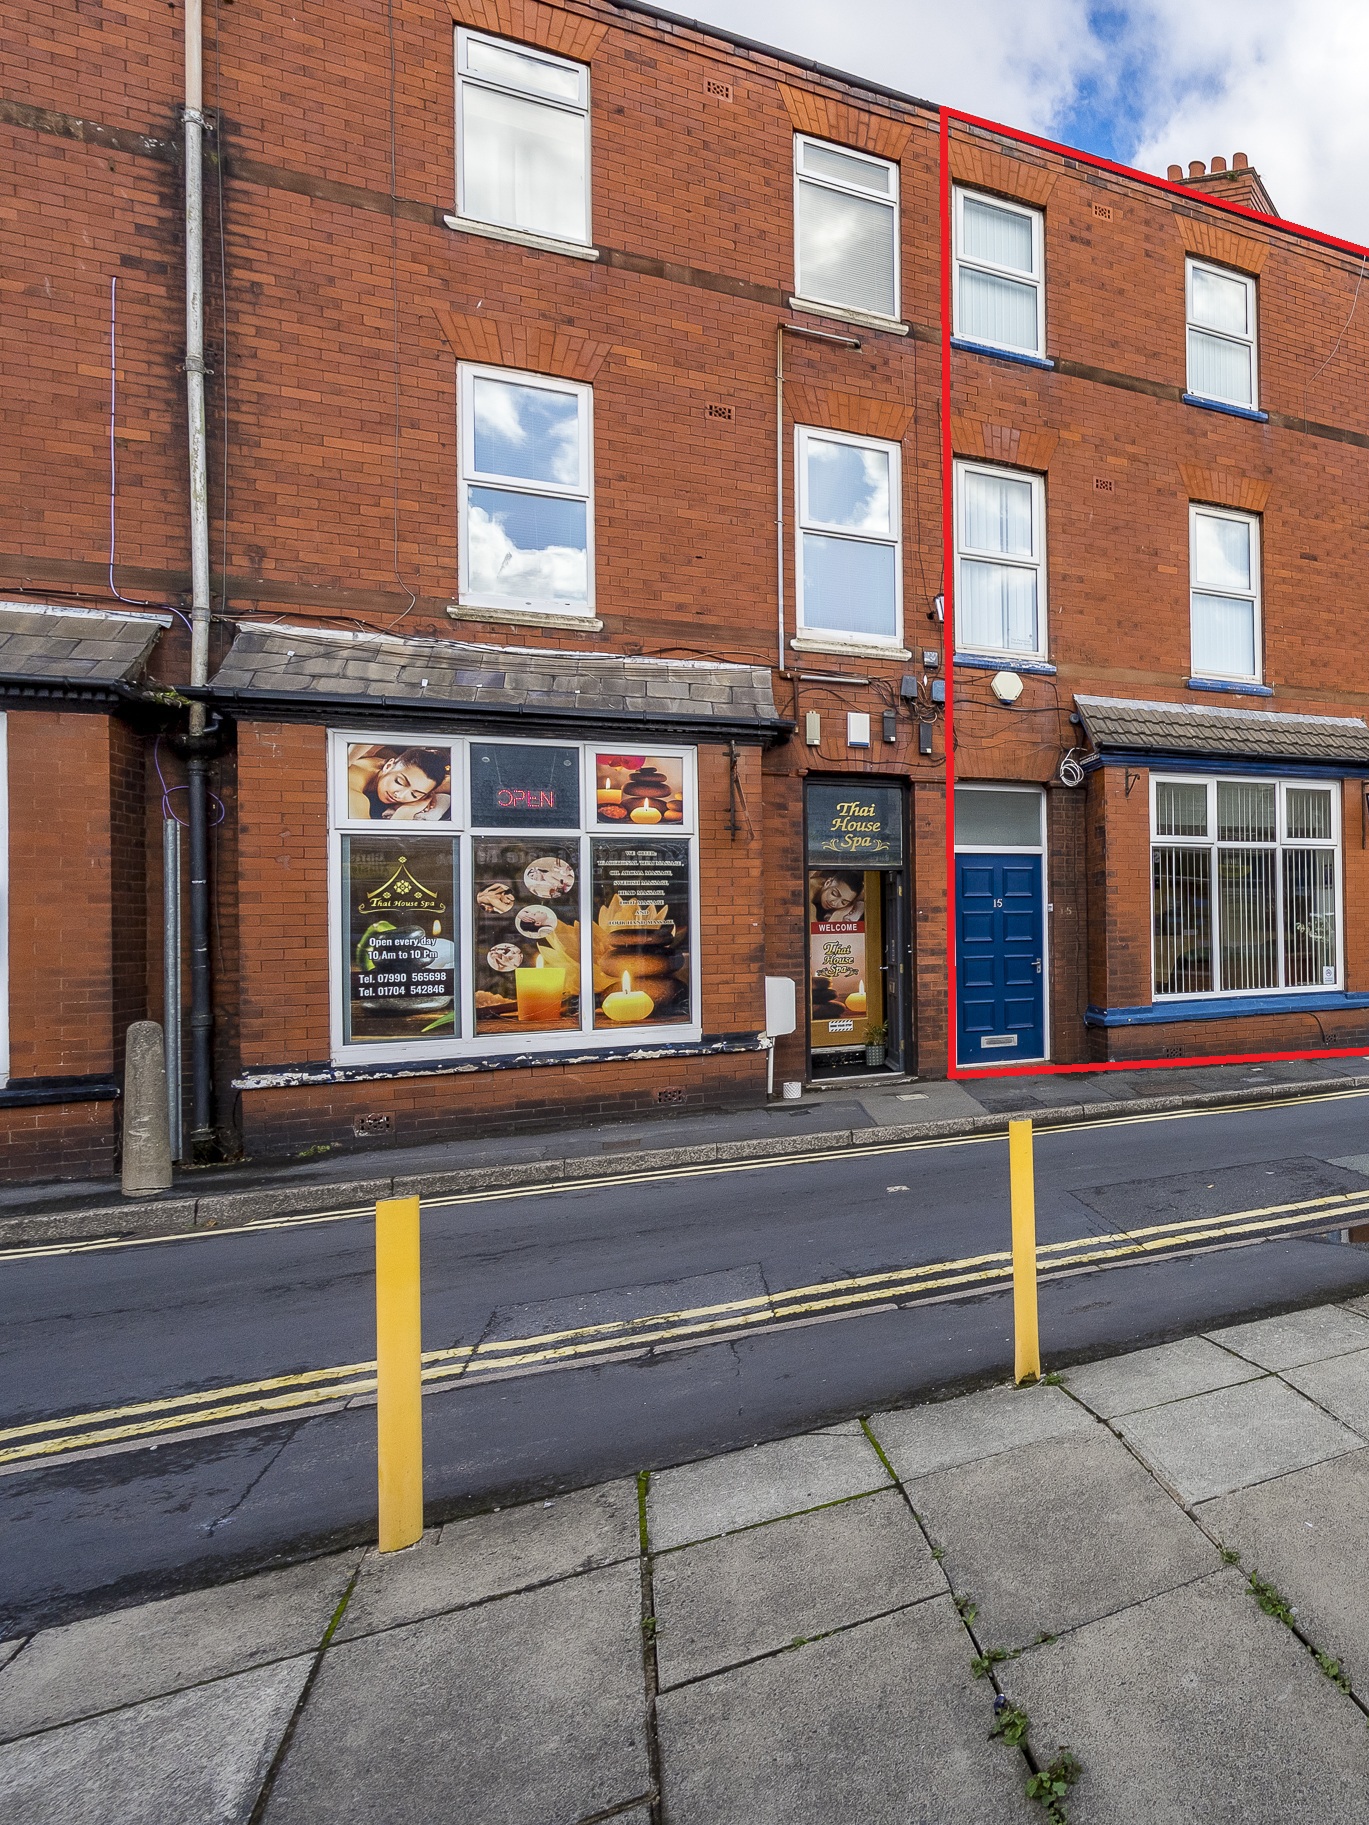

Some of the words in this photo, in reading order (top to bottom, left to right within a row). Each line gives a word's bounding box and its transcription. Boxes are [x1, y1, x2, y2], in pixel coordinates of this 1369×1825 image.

[498, 789, 554, 808] OPEN
[836, 802, 876, 816] Thai
[831, 817, 880, 832] House
[841, 834, 872, 852] Spa
[370, 898, 391, 907] Thai
[993, 899, 1003, 908] 15
[1060, 906, 1072, 915] 15
[819, 924, 857, 932] WELCOME
[369, 937, 392, 947] Open
[395, 938, 420, 947] every
[421, 937, 437, 946] day
[823, 941, 851, 955] Thai
[368, 952, 379, 960] 10
[410, 950, 420, 958] 10
[423, 950, 438, 958] Pm
[822, 955, 854, 965] House
[828, 965, 848, 977] Spa
[359, 974, 375, 983] Tel.
[378, 974, 406, 983] 07990
[412, 972, 447, 981] 565698
[359, 988, 375, 996] Tel.
[378, 986, 405, 995] 01704
[410, 985, 445, 994] 542846
